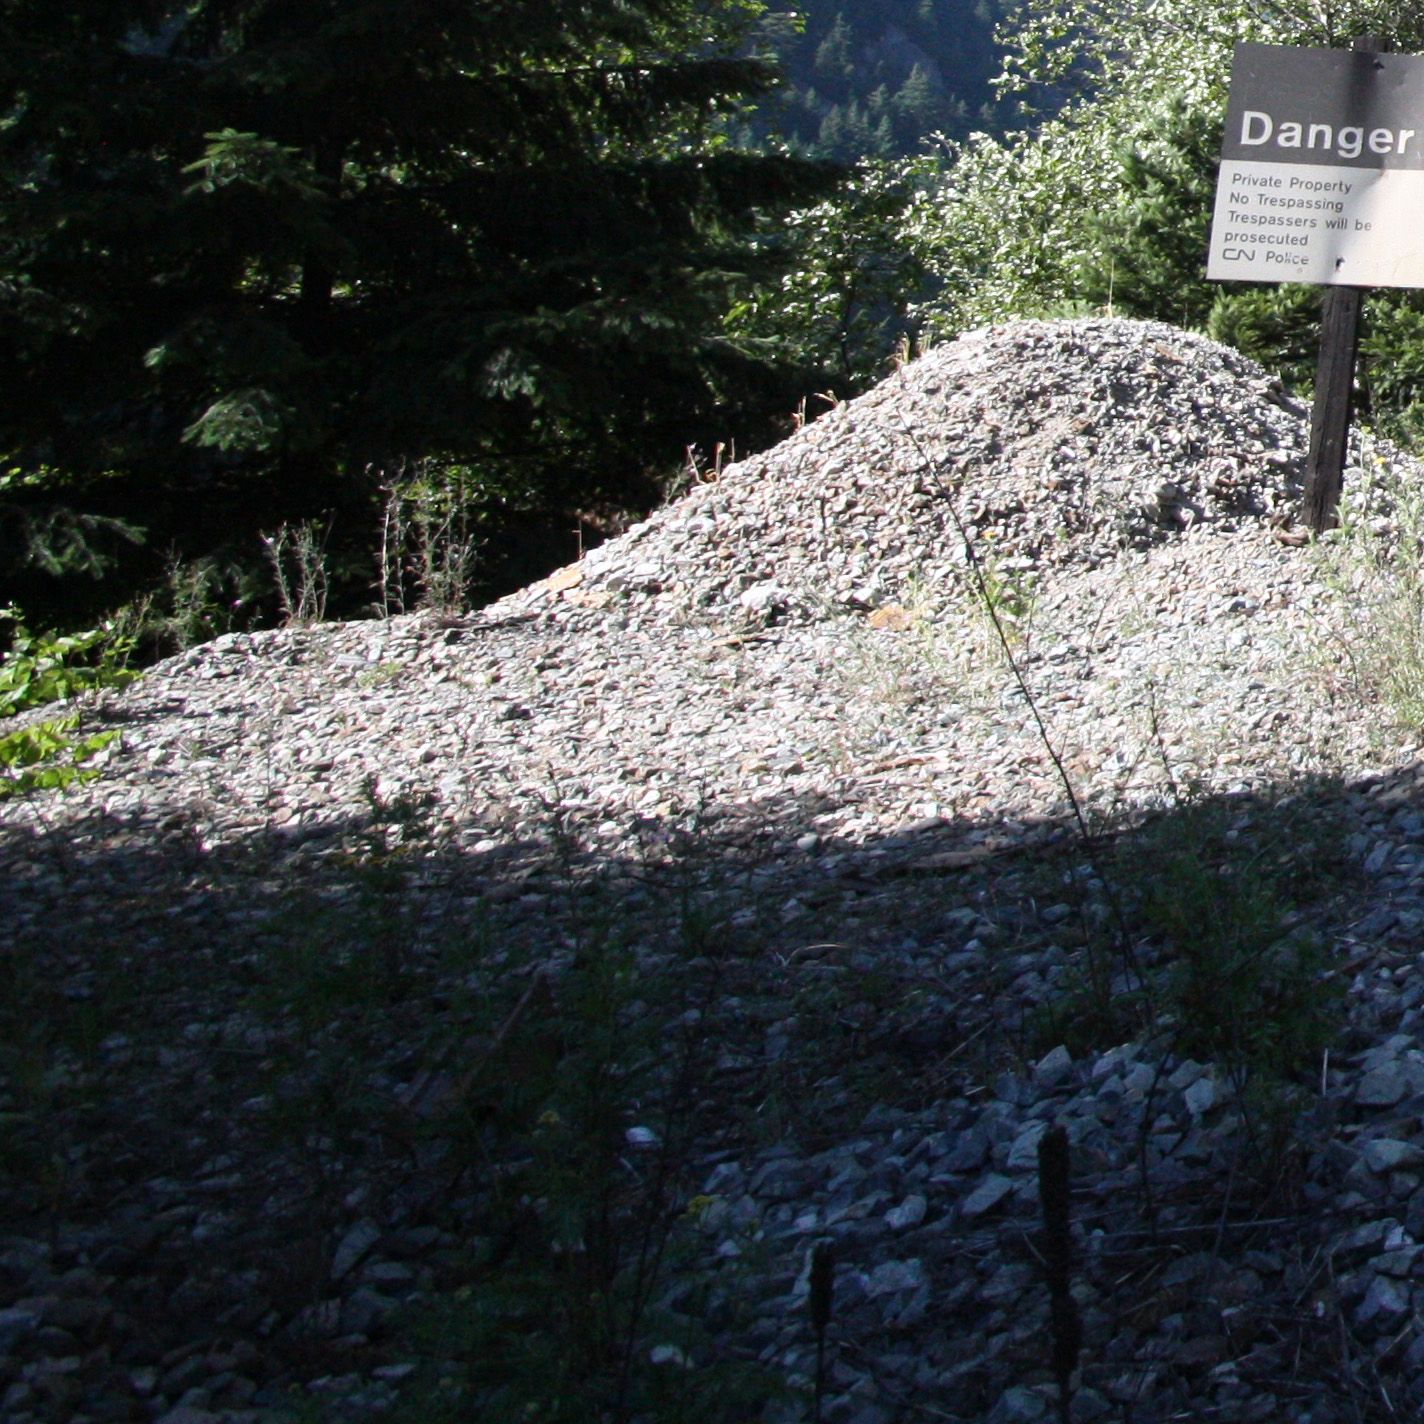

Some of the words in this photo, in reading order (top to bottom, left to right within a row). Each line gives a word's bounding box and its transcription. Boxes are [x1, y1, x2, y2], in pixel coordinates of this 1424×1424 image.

[1240, 110, 1415, 159] Danger
[1232, 173, 1282, 188] Private
[1289, 177, 1353, 195] Property
[1229, 192, 1249, 205] No
[1257, 193, 1344, 213] Trespassing
[1228, 210, 1318, 228] Trespassers
[1325, 218, 1348, 230] will
[1354, 219, 1372, 231] be
[1223, 231, 1309, 246] prosecuted
[1222, 248, 1256, 261] CN
[1265, 250, 1310, 265] Police
